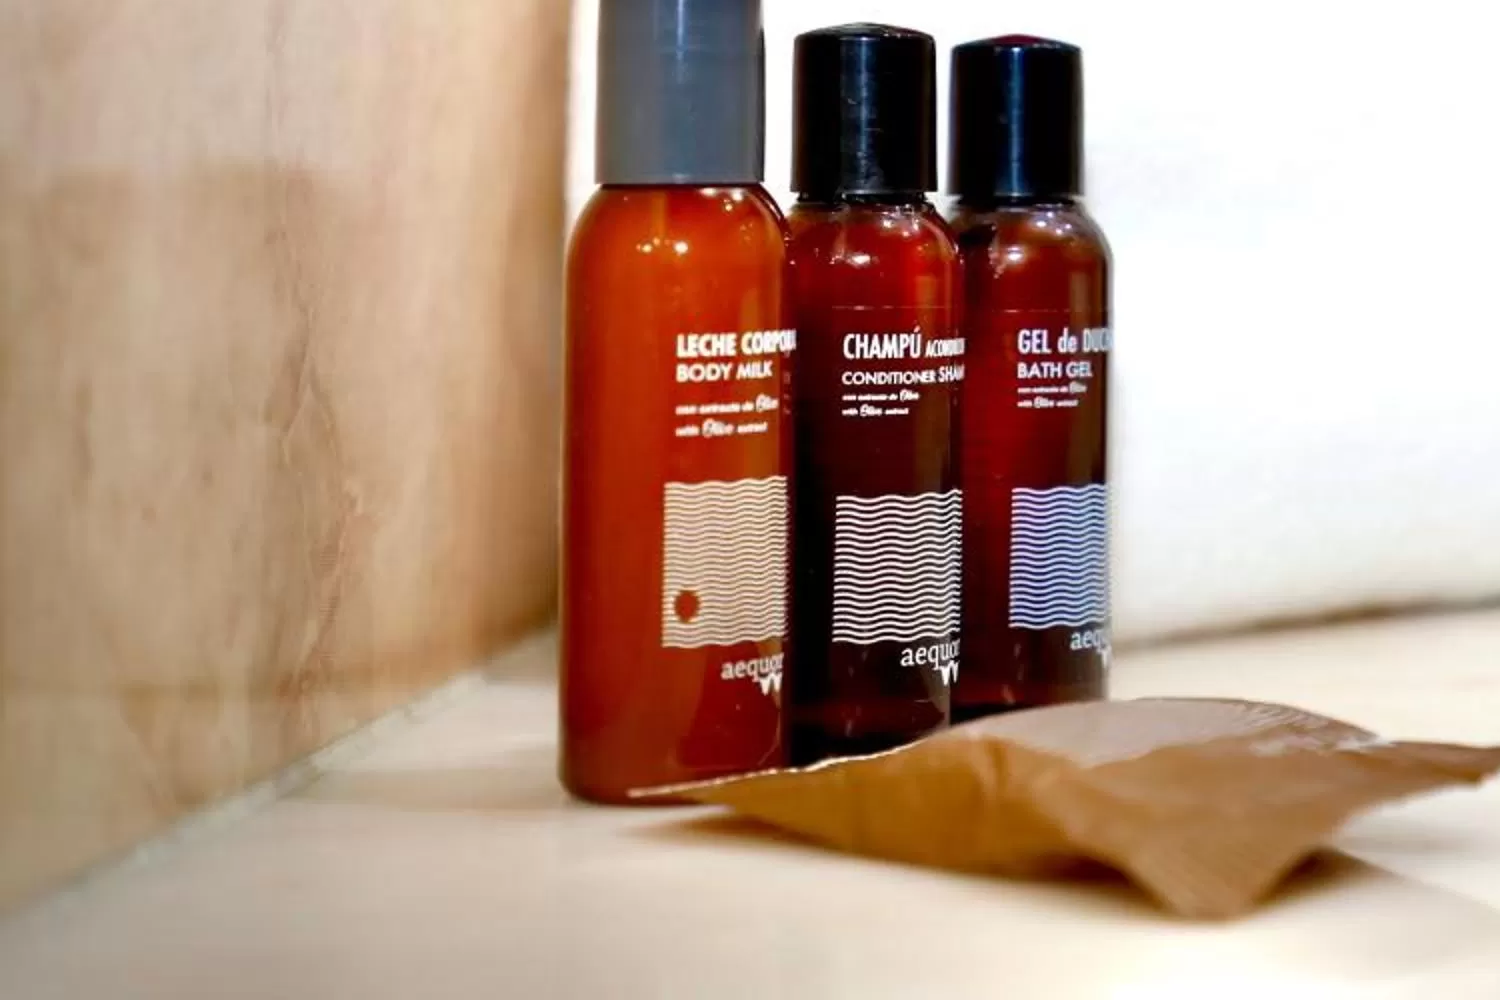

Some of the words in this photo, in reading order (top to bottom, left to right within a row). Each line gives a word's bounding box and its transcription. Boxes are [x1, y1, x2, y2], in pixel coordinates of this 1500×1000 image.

[677, 333, 738, 358] LECHE
[843, 325, 922, 359] CHAMPÚ
[1017, 329, 1052, 354] GEL
[1057, 327, 1078, 354] de
[675, 363, 733, 383] BODY
[736, 360, 773, 380] MILK
[841, 370, 936, 385] CONDITIONER
[1017, 362, 1062, 379] BATH
[1065, 361, 1093, 378] GEL
